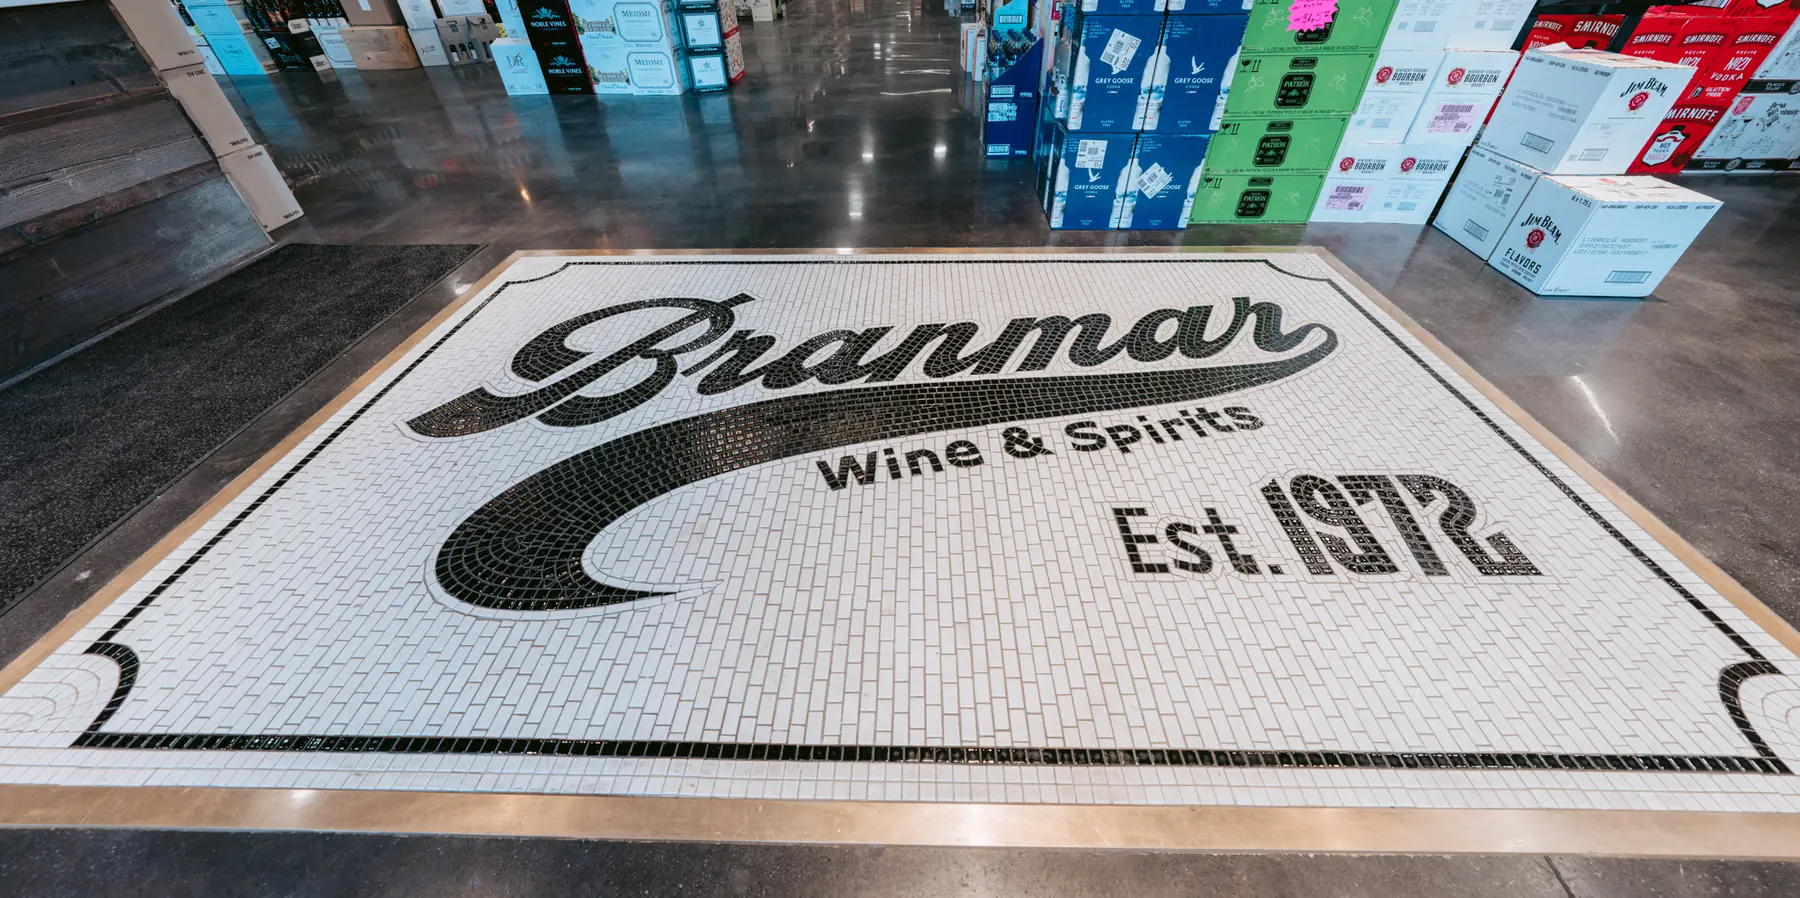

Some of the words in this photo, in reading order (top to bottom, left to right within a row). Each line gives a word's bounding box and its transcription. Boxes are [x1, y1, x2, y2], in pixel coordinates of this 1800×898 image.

[1533, 20, 1563, 32] SMIRNOFF
[1632, 34, 1673, 44] SMIRNOFF
[1683, 34, 1723, 44] SMIRNOFF
[1735, 34, 1777, 44] SMIRNOFF
[1392, 73, 1426, 81] BOURBON
[1464, 74, 1499, 83] BOURBON
[1710, 72, 1744, 82] VODKA
[1620, 81, 1644, 97] JIM
[1646, 77, 1668, 97] BEAM
[1666, 108, 1718, 121] MIRNOFF
[1416, 163, 1448, 171] BOURBON
[1520, 213, 1542, 227] JIM
[1541, 215, 1562, 244] BEAM
[1505, 248, 1542, 275] FLAVORS
[406, 292, 1338, 440] Branmar
[816, 440, 985, 491] Wine
[1001, 427, 1055, 459] &
[1064, 405, 1265, 453] Spirits
[1112, 506, 1285, 575] Est.
[1260, 473, 1543, 576] 1972
